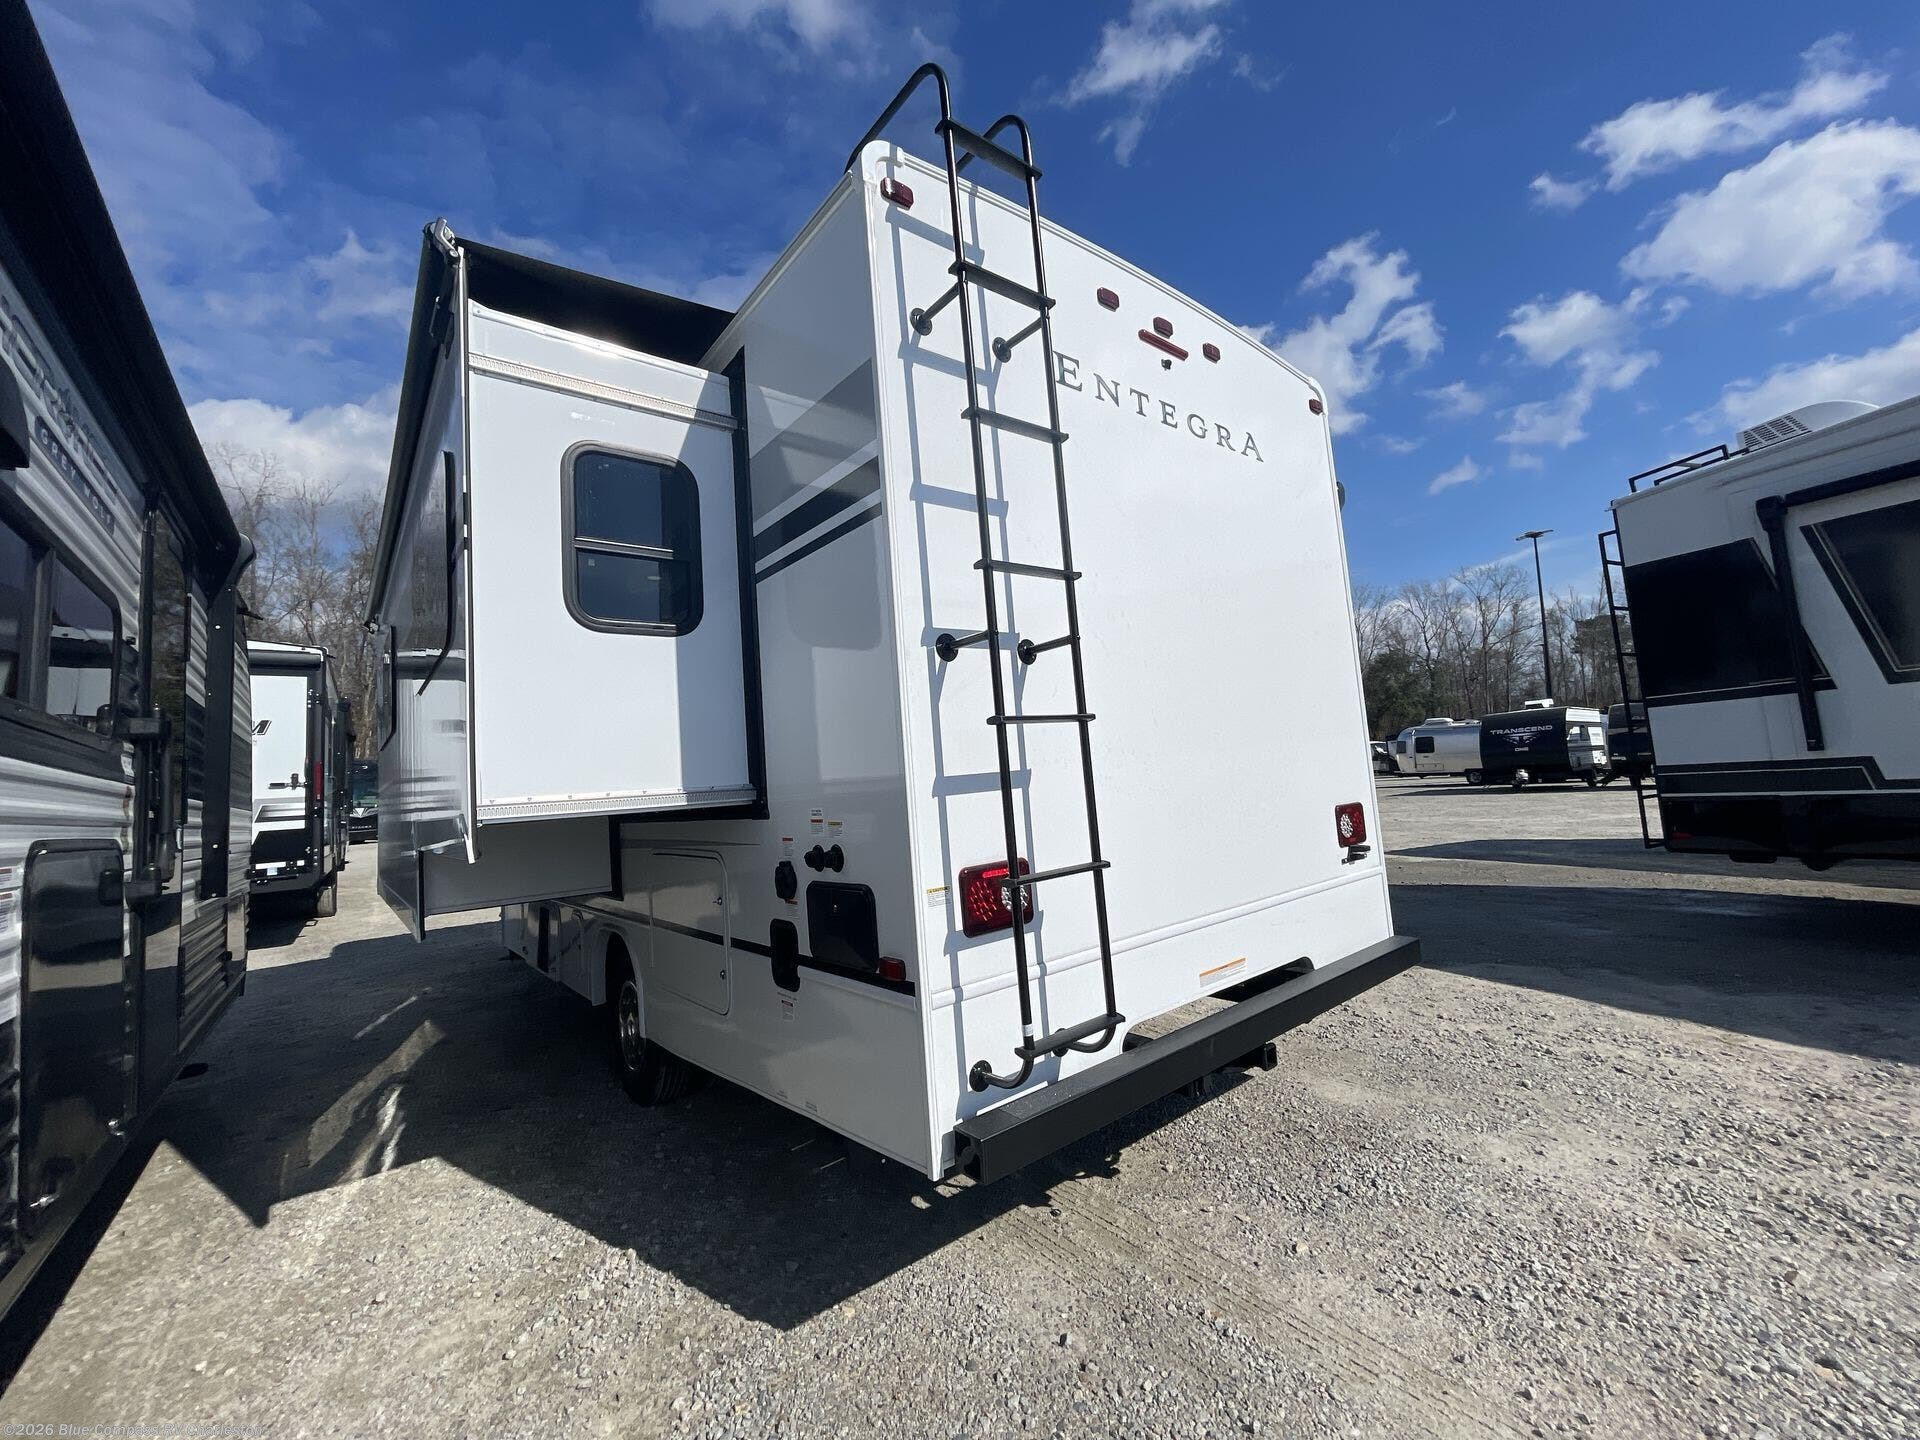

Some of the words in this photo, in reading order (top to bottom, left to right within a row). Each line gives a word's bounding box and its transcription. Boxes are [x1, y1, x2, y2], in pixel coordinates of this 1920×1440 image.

[1053, 350, 1264, 463] ENTEGRA
[41, 428, 77, 481] GREY
[1490, 725, 1553, 735] TRANSCEND
